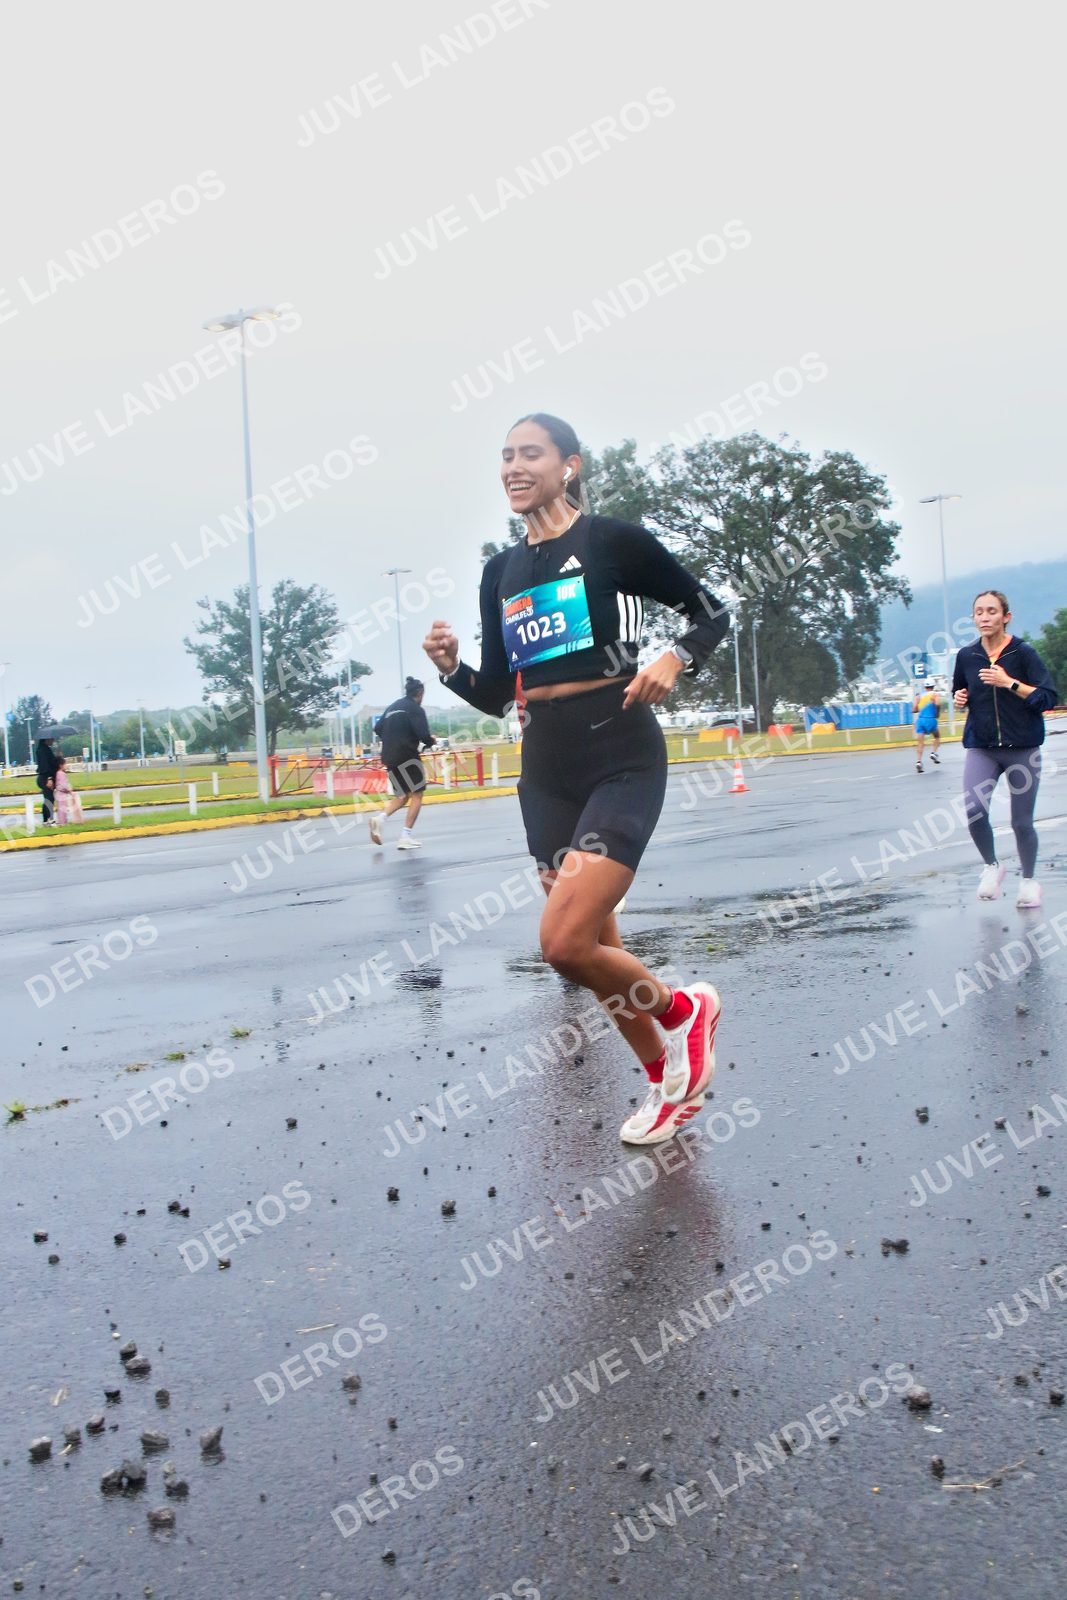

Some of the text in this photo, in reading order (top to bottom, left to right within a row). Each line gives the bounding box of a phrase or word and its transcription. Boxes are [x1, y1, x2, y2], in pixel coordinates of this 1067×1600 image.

[556, 583, 577, 602] 10K
[516, 611, 567, 646] 1023
[914, 663, 925, 676] E
